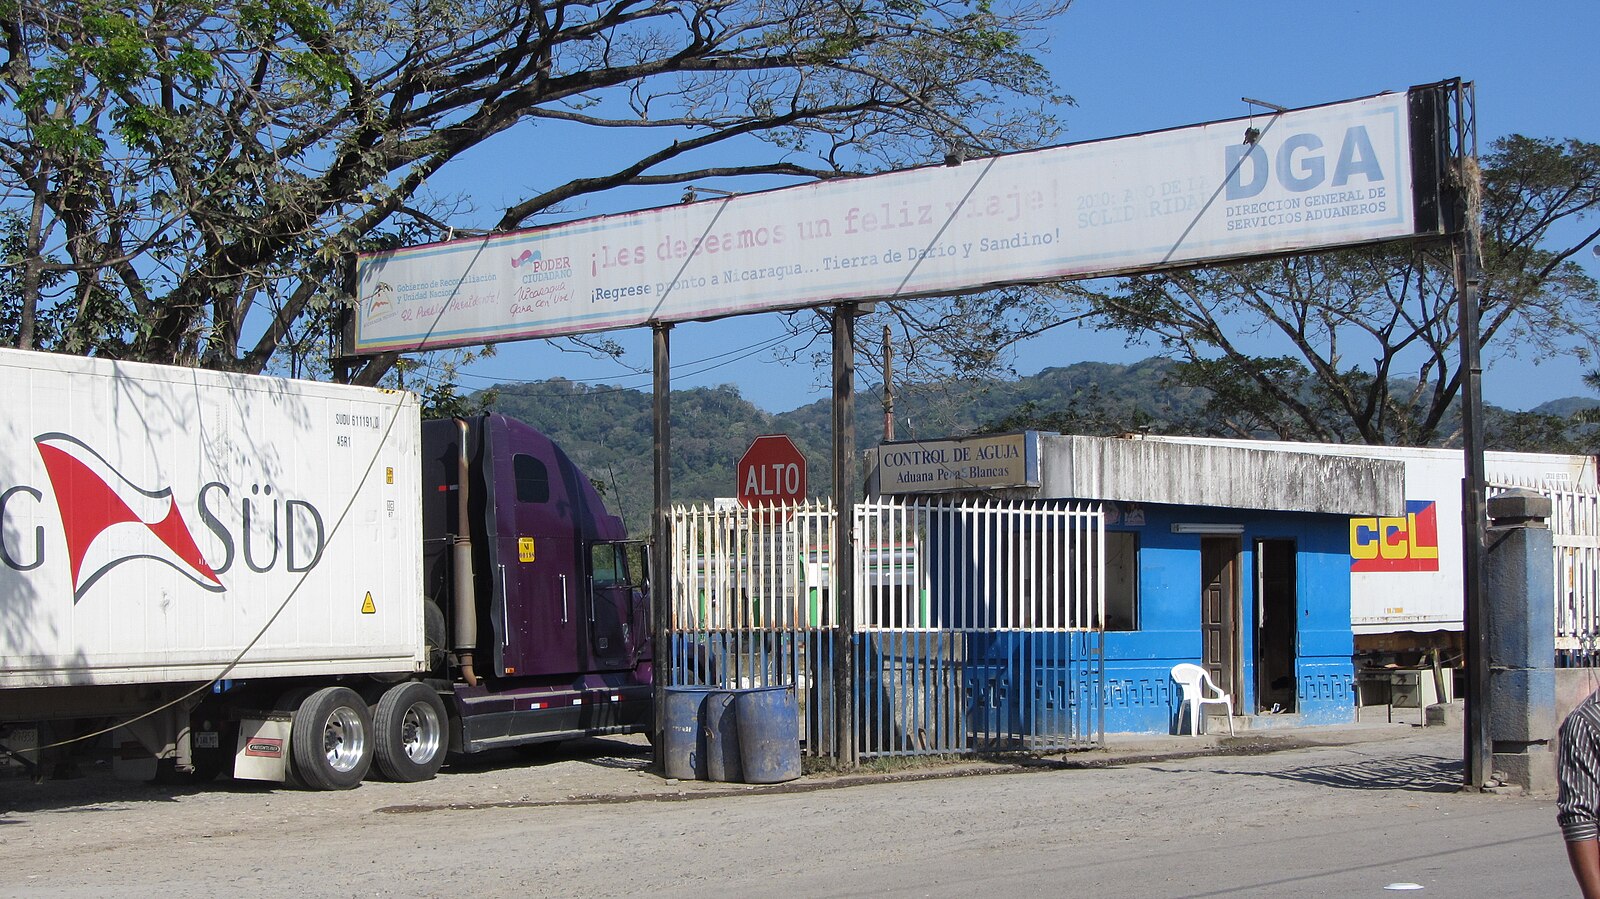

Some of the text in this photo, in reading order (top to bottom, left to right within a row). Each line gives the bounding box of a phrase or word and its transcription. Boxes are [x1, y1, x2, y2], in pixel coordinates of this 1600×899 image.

[1225, 125, 1385, 201] DGA
[1161, 179, 1182, 196] DE
[1226, 186, 1387, 218] DIRECCION GENERAL DE
[1226, 200, 1387, 231] SERVICIOS ADUANEROS
[656, 223, 786, 262] deseamos
[797, 217, 832, 241] un
[843, 200, 933, 235] feliz
[533, 256, 571, 273] PODER
[655, 275, 706, 297] pronto
[711, 275, 720, 286] a
[822, 254, 879, 271] Tierra
[883, 248, 902, 264] de
[907, 241, 957, 262] Darío
[962, 241, 973, 259] y
[979, 227, 1061, 252] Sandino!
[396, 281, 429, 294] Gobierno
[430, 279, 438, 289] de
[522, 268, 573, 285] CIUDADANO
[396, 296, 402, 305] y
[403, 289, 428, 302] Unidad
[336, 435, 351, 448] 45R1
[884, 444, 1020, 468] CONTROL DE AGUJA
[744, 462, 800, 496] ALTO
[896, 470, 934, 484] Aduana
[969, 466, 1010, 479] Blancas
[198, 481, 325, 574] SÜD
[1350, 512, 1438, 560] CCL
